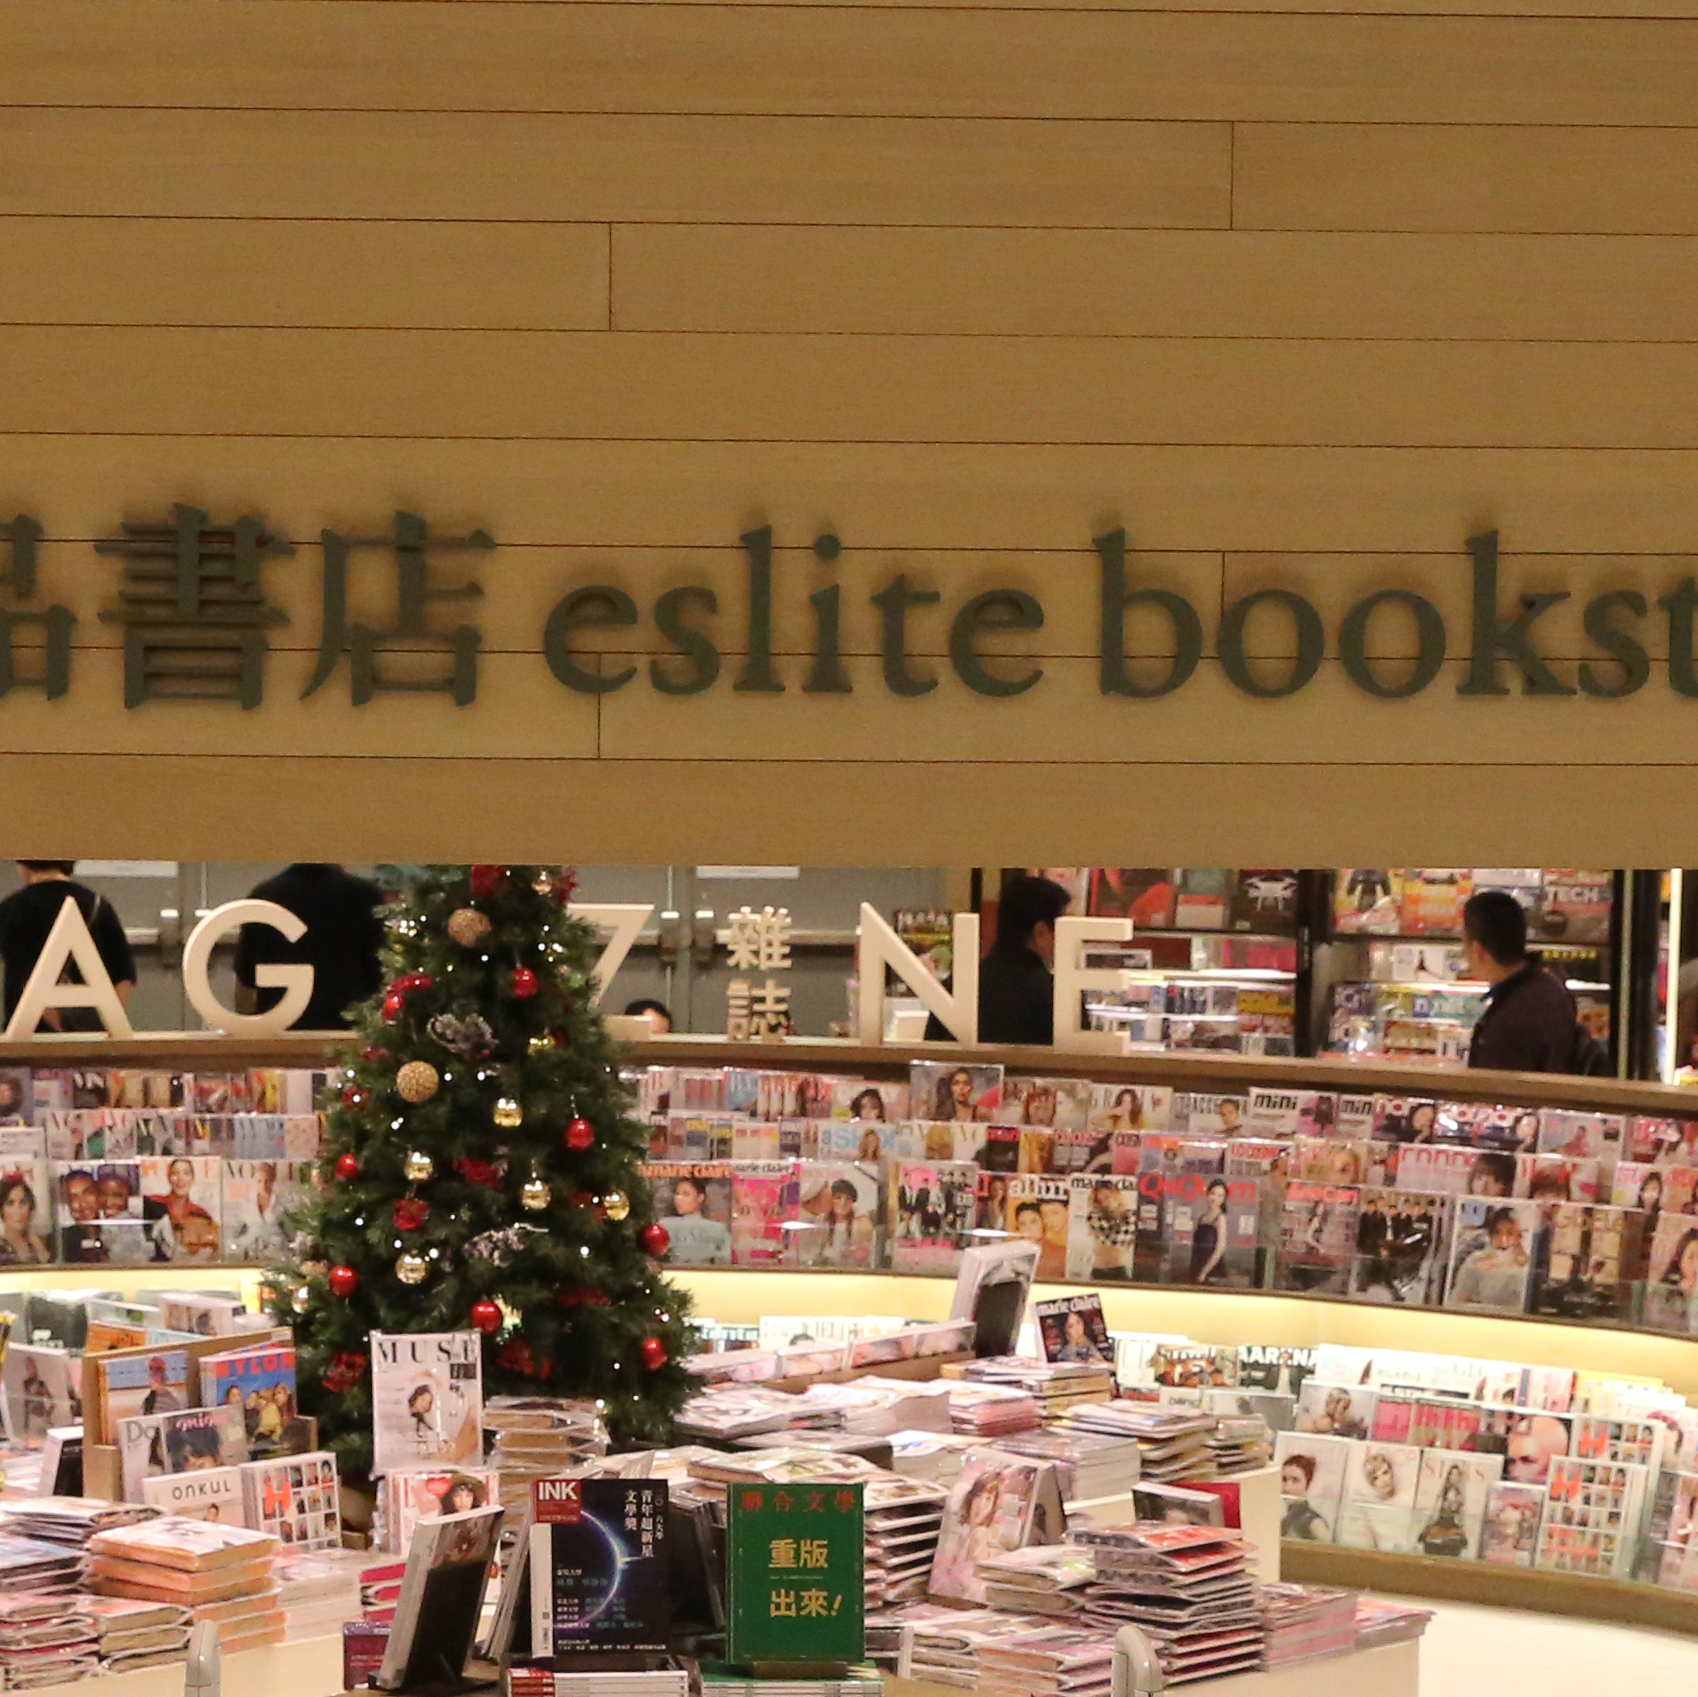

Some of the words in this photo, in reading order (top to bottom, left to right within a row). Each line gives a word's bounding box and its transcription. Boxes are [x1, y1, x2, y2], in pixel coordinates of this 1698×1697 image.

[545, 529, 1046, 697] eslite
[726, 905, 792, 1042] 雜誌
[1253, 1093, 1297, 1110] mini
[1340, 1098, 1372, 1116] min
[1036, 1301, 1068, 1316] marie
[1069, 1295, 1101, 1311] claire
[378, 1340, 477, 1364] MUSE
[215, 1352, 296, 1379] NYLON
[538, 1481, 578, 1501] INK
[741, 1490, 856, 1513] 聯合文學
[768, 1538, 829, 1569] 重版
[769, 1587, 844, 1618] 出來!
